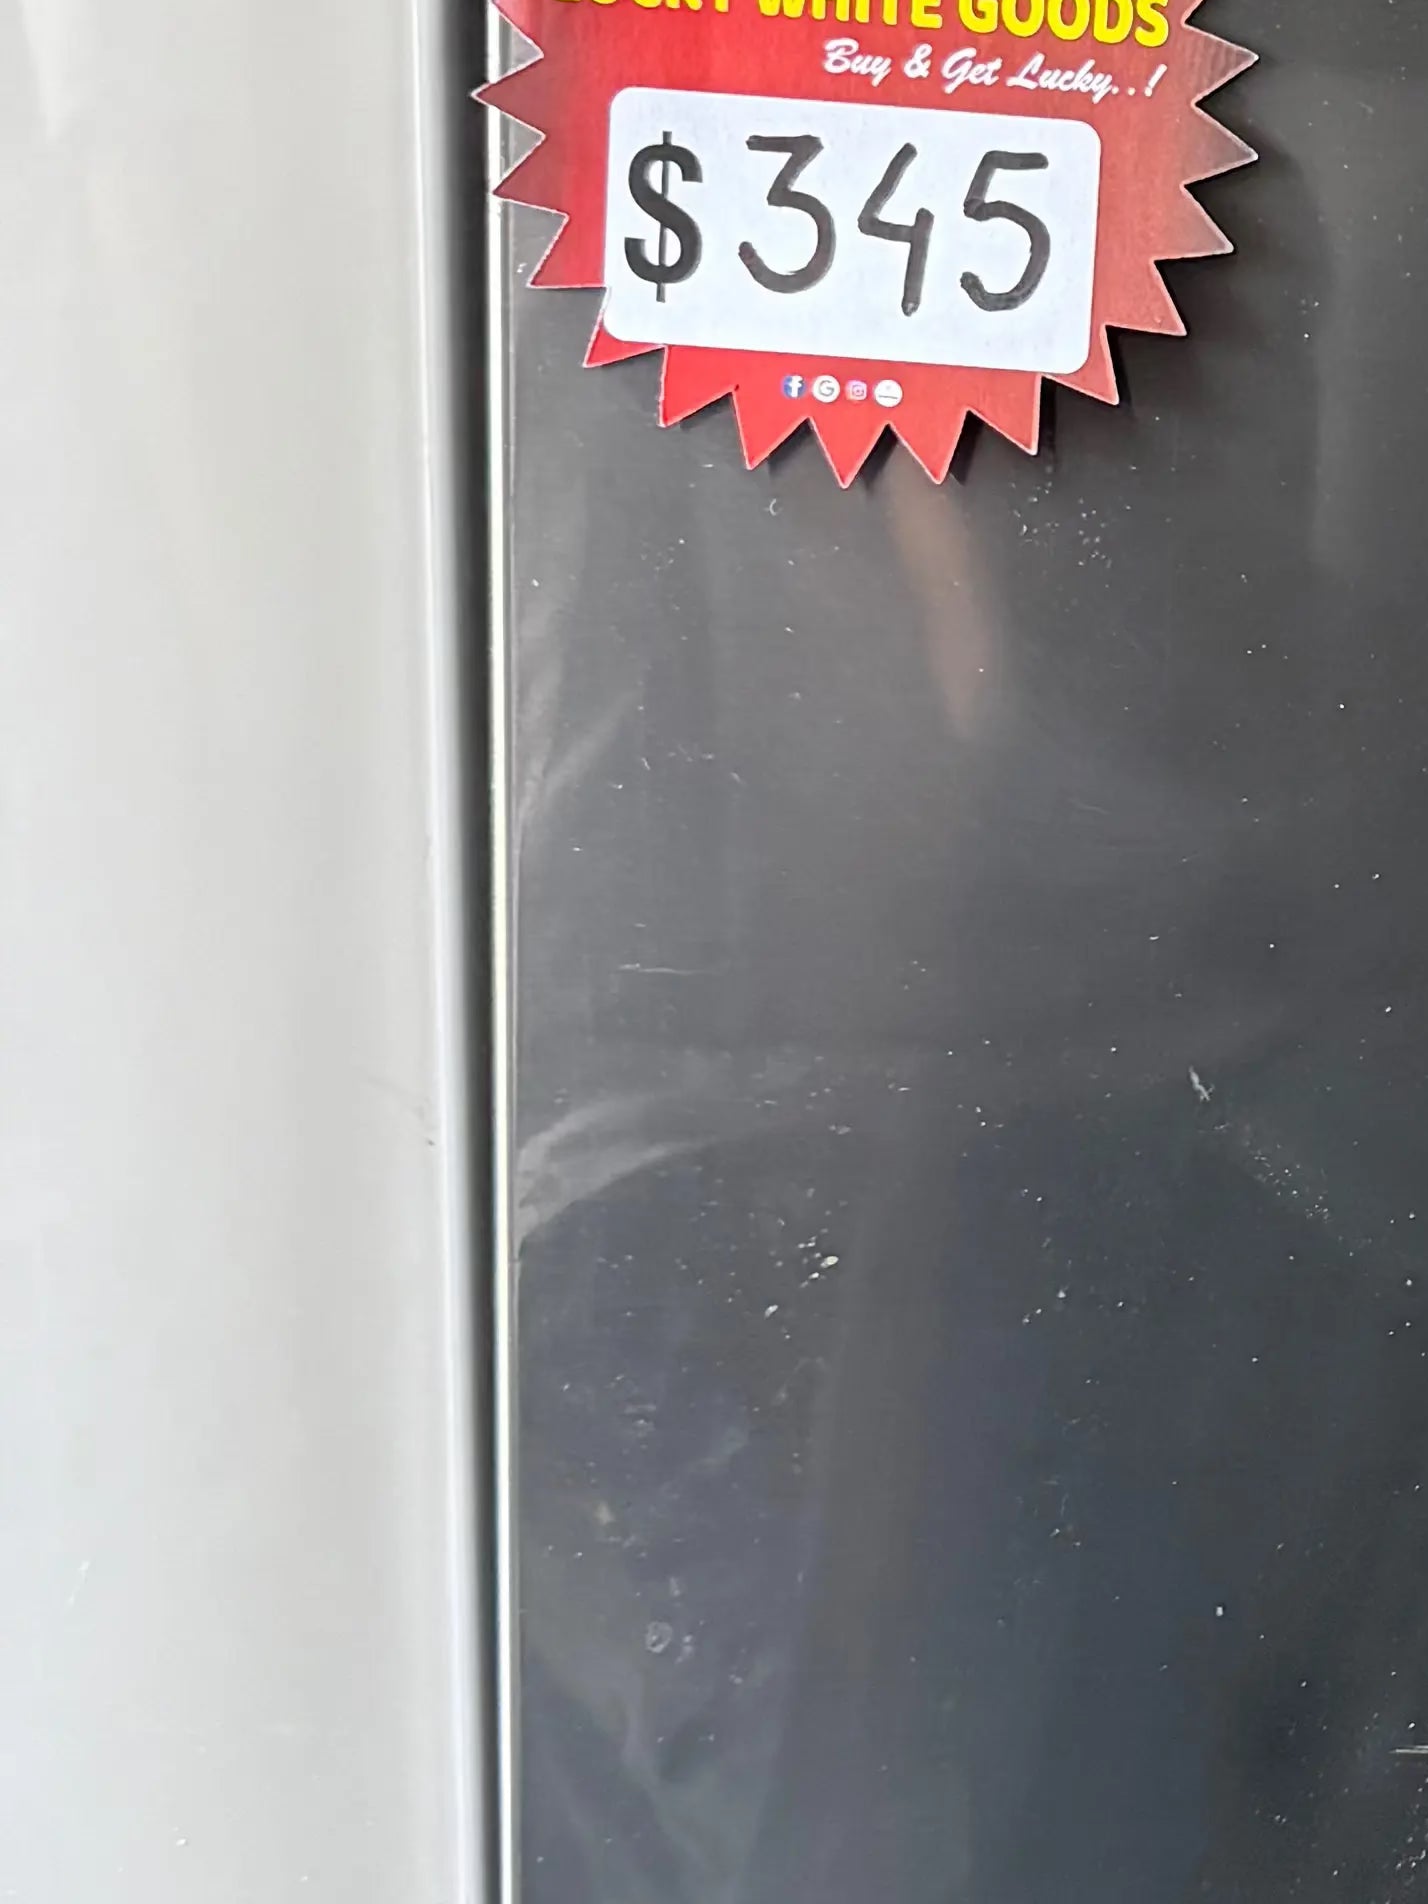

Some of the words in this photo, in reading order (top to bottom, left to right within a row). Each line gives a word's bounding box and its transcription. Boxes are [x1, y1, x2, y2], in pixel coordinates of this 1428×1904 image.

[823, 37, 892, 87] Buy
[903, 43, 933, 79] &
[941, 47, 1003, 95] Get
